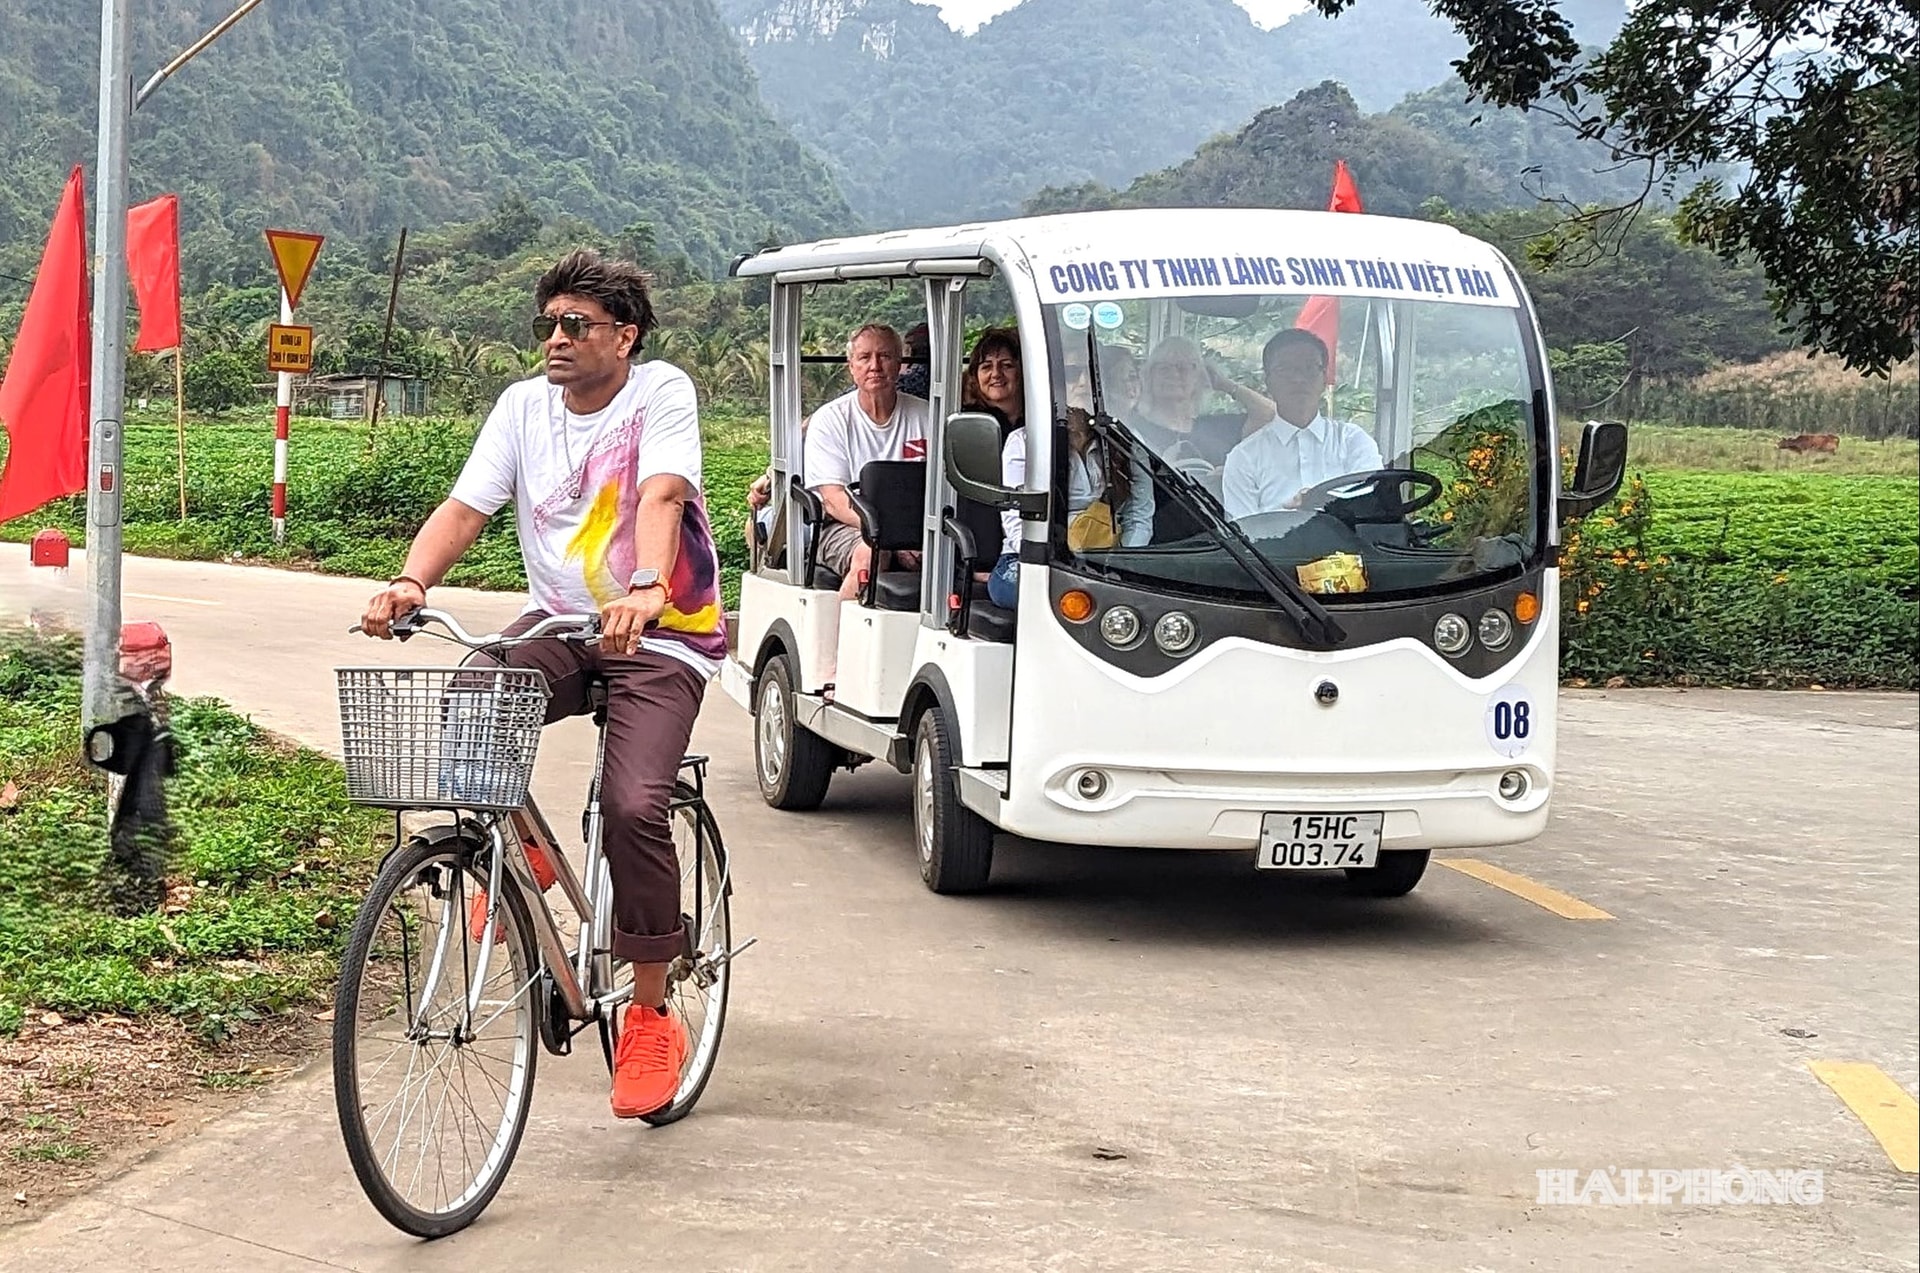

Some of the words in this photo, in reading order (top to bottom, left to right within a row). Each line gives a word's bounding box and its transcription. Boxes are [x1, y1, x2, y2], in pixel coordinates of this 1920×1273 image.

[1049, 258, 1120, 295] CÔNG
[1119, 259, 1150, 289] TY
[1152, 257, 1222, 287] TNHH
[1286, 257, 1347, 287] SINH
[1494, 701, 1530, 740] 08
[1292, 816, 1358, 840] 15HC
[1271, 842, 1364, 866] 003.74
